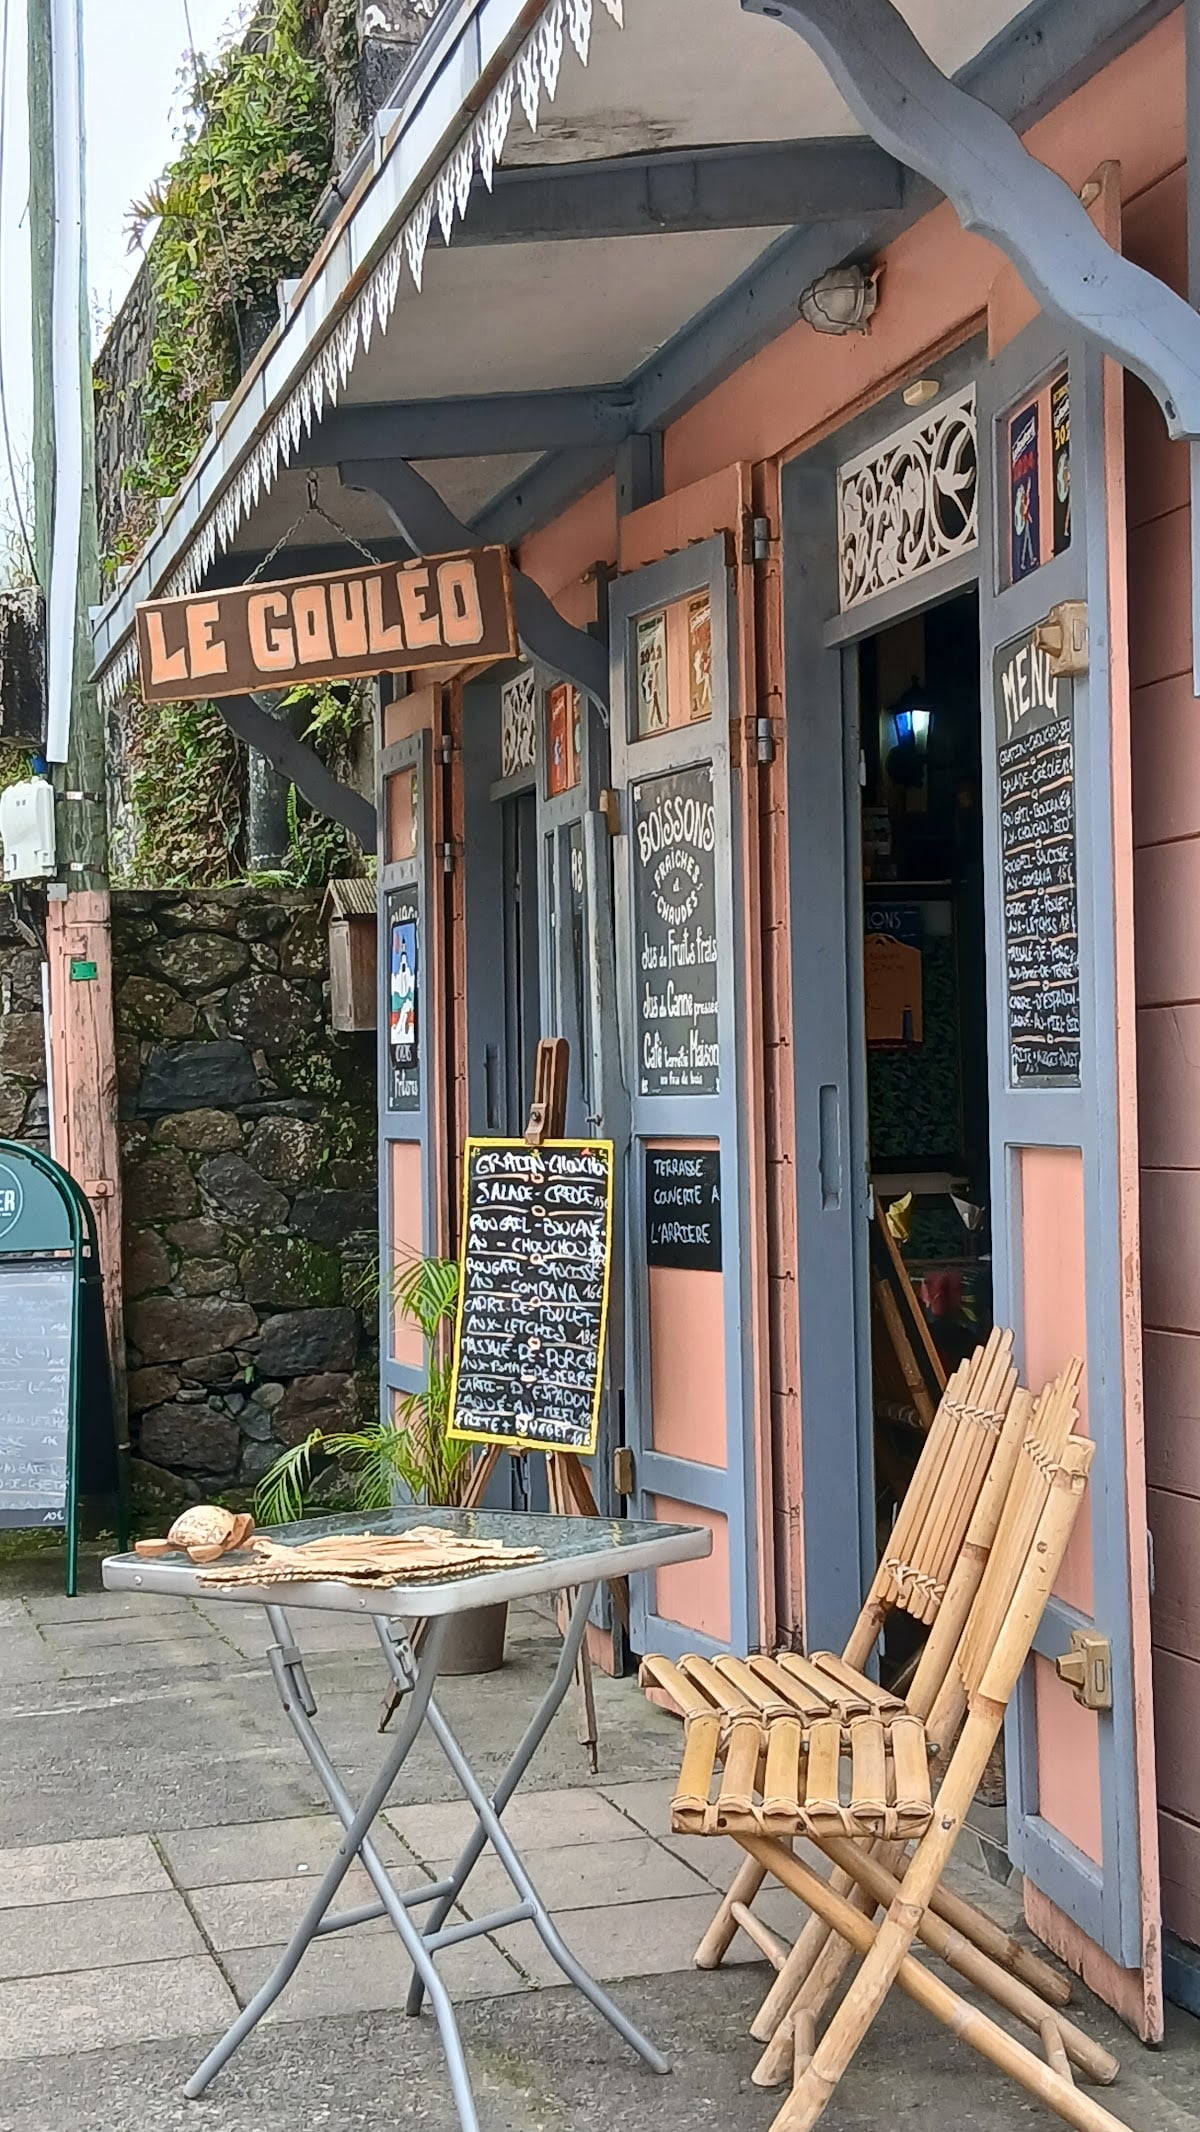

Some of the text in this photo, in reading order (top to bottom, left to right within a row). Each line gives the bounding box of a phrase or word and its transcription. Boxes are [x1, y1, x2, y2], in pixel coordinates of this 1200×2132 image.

[146, 558, 484, 685] LE GOULÉO
[657, 890, 698, 926] CHAUDES
[653, 1159, 703, 1177] TERRASSE
[476, 1182, 533, 1204] SALADE
